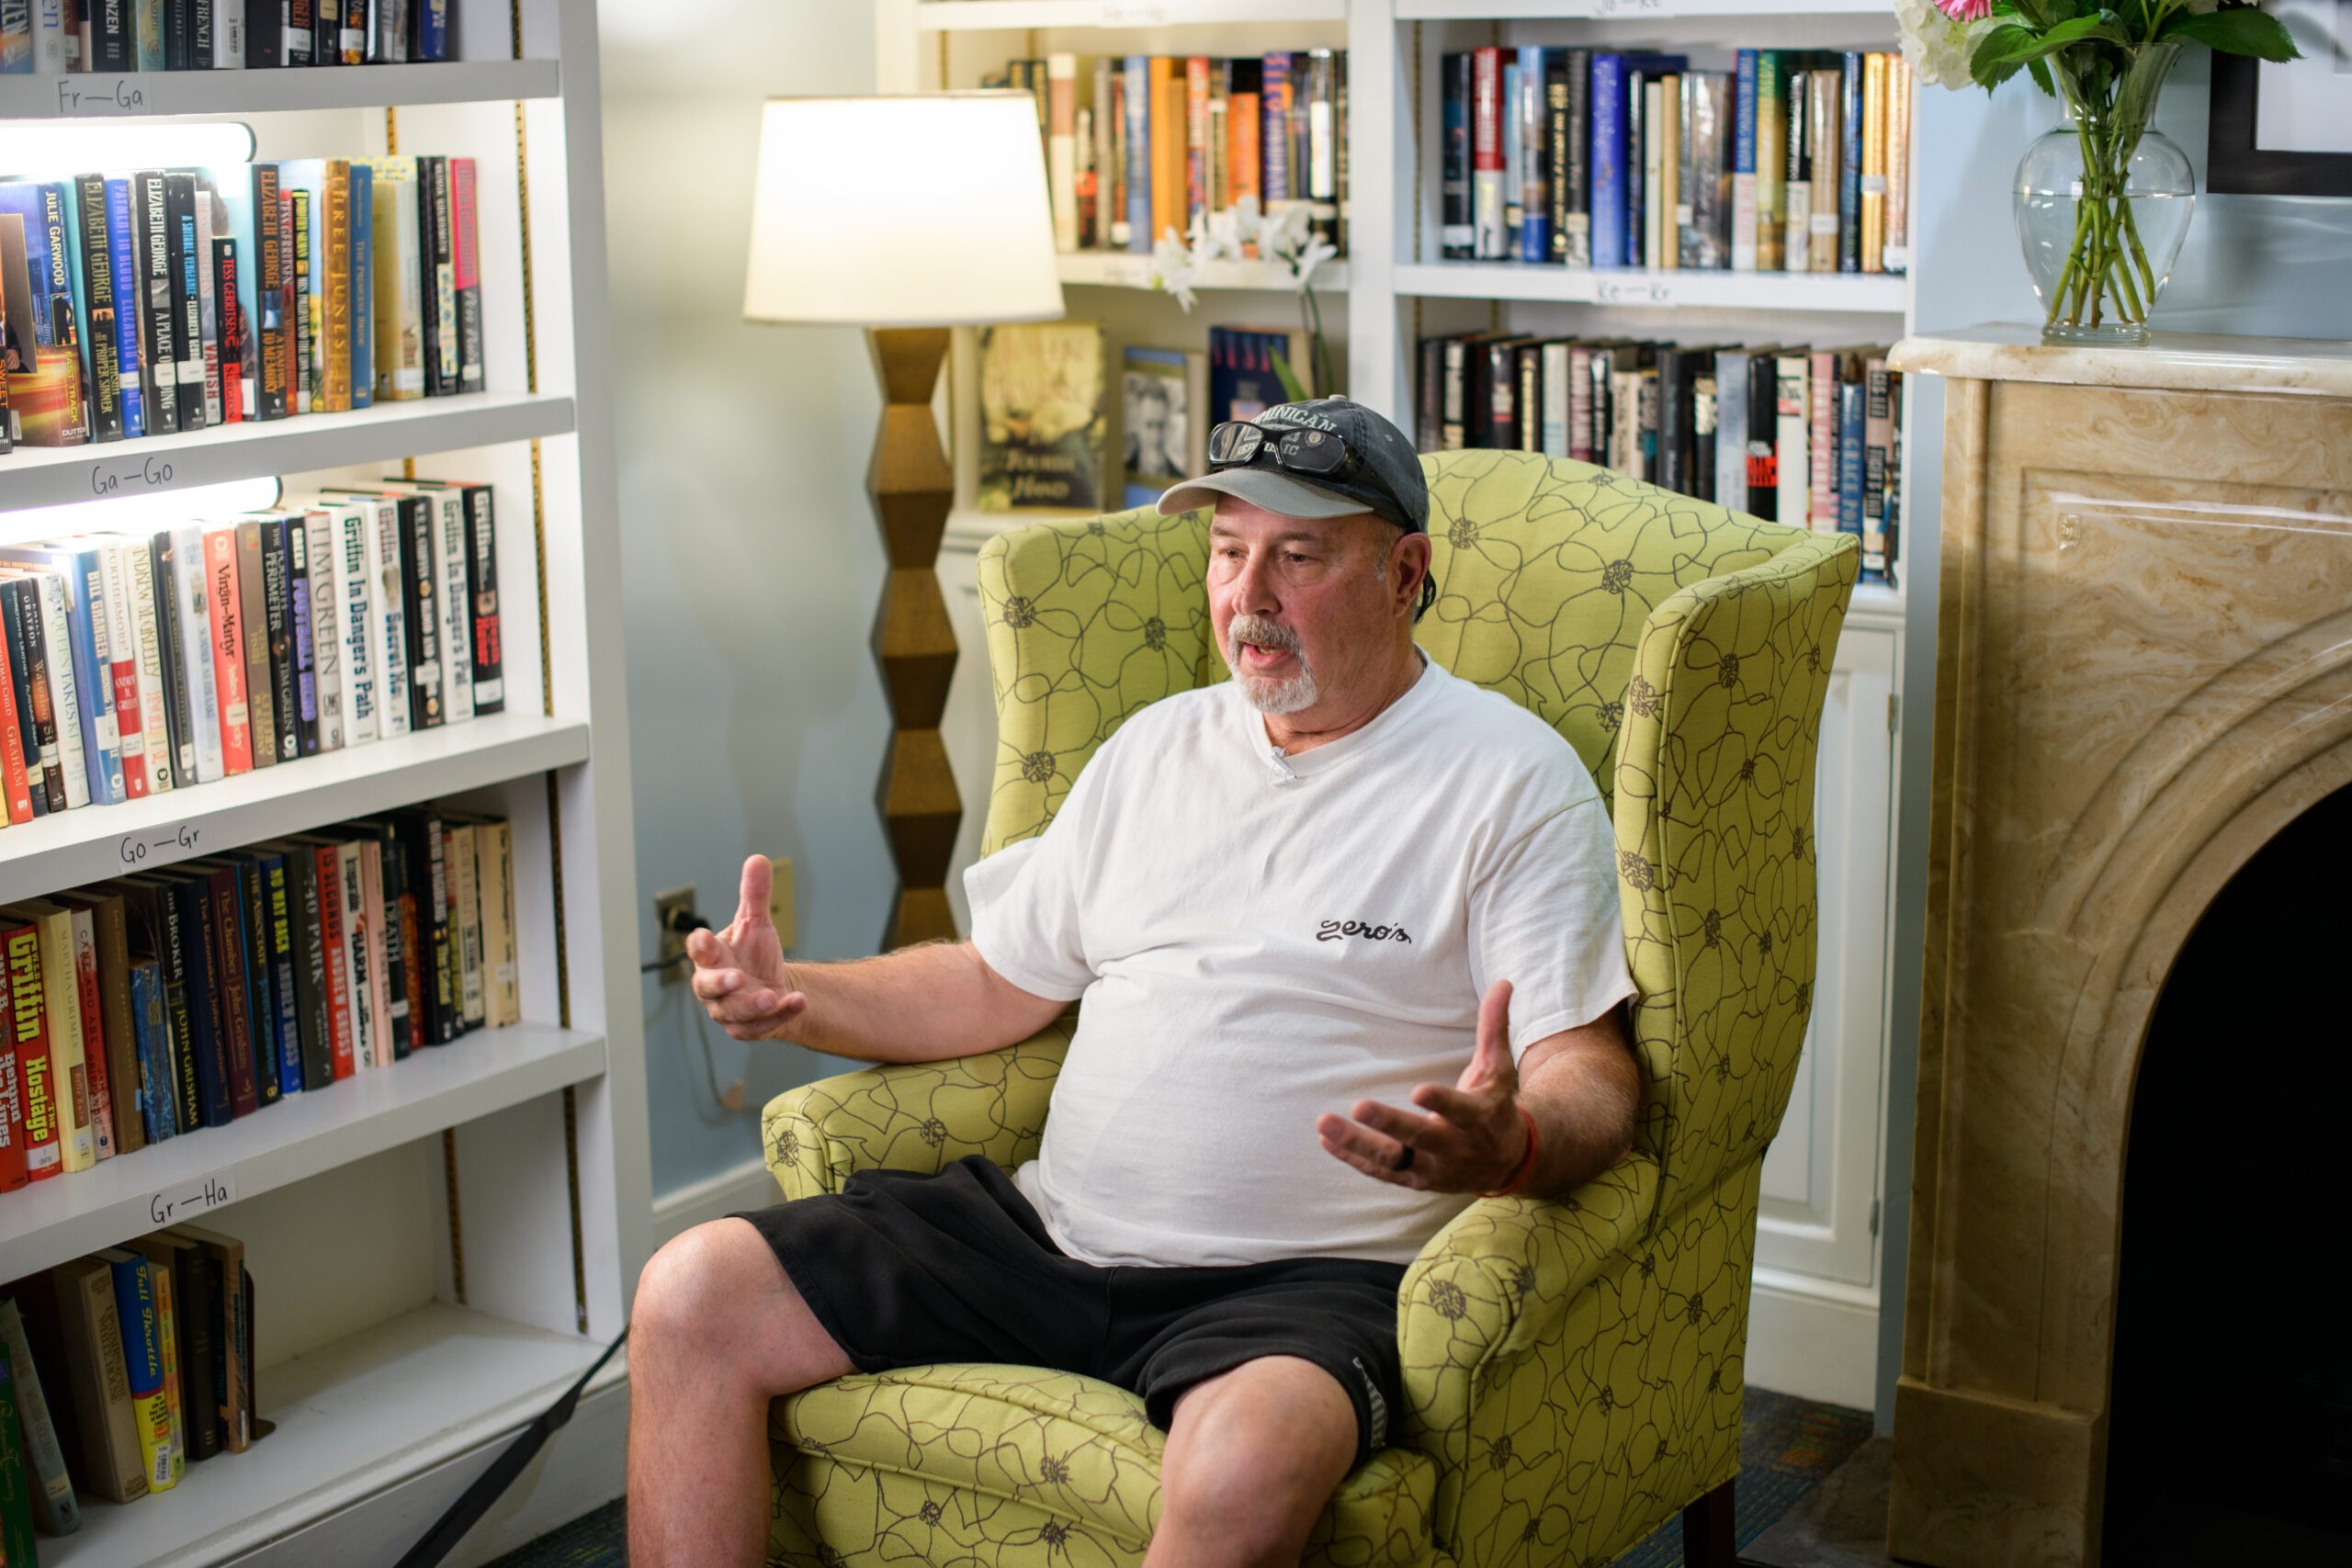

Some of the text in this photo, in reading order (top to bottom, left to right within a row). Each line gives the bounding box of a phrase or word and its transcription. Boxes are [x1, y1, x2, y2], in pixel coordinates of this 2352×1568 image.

[45, 191, 65, 287] JULIE GARWOOD
[85, 181, 111, 304] ELIZABETH GEORGE
[114, 186, 129, 234] PAYMENT
[147, 178, 168, 276] ELIZABETH GEORGE
[182, 222, 195, 254] SUITABLE
[261, 171, 279, 288] ELIZABETH GEORGE
[280, 199, 293, 285] TESS GERRITSEN
[119, 254, 133, 291] BLOOD
[184, 256, 198, 296] VENGEANCE
[222, 258, 237, 336] TESS GERRITSEN
[330, 175, 348, 350] THREE JUNES
[121, 299, 137, 359] ELIZABETH
[156, 321, 172, 355] PLACE
[187, 300, 199, 337] ELIZABETH
[64, 351, 80, 423] FAST TRACK
[98, 344, 112, 413] PROPER SINNER
[204, 344, 219, 400] VANISH
[263, 344, 277, 395] MEMORY
[311, 521, 332, 577] TIM
[86, 570, 112, 703] BILL GRANGER BURNING
[141, 622, 161, 678] GREELEY
[266, 552, 295, 731] PERIMETER TIM GREEN
[291, 527, 317, 722] GREEN FOOTBALL HERO
[314, 581, 338, 677] GREEN
[345, 516, 374, 720] Griffin In Danger's Path
[23, 595, 51, 721] GRAYSON Waterloo
[51, 615, 77, 721] QUEEN TAKES
[3, 687, 23, 787] CHILD GRAHAM
[270, 868, 284, 883] NO
[273, 886, 287, 917] WAY
[60, 930, 74, 992] MARTHA
[169, 913, 184, 979] BROKER
[223, 916, 237, 976] Chamber
[275, 919, 290, 954] BACK
[309, 923, 325, 984] PARK
[322, 852, 352, 1058] 15 SECONDS ANDREW GROSS
[352, 931, 367, 987] HARM
[9, 932, 45, 1043] Griffin
[66, 995, 80, 1049] GRIMES
[81, 929, 93, 971] CANE
[88, 1016, 98, 1044] ABE
[180, 1009, 192, 1052] JOHN
[4, 1052, 22, 1123] Behind
[25, 1055, 50, 1144] Hostage
[48, 1103, 56, 1130] The
[183, 1055, 198, 1126] GRISHAM
[135, 1266, 157, 1379] Full Throttle
[98, 1314, 118, 1405] WHITE HOUSE
